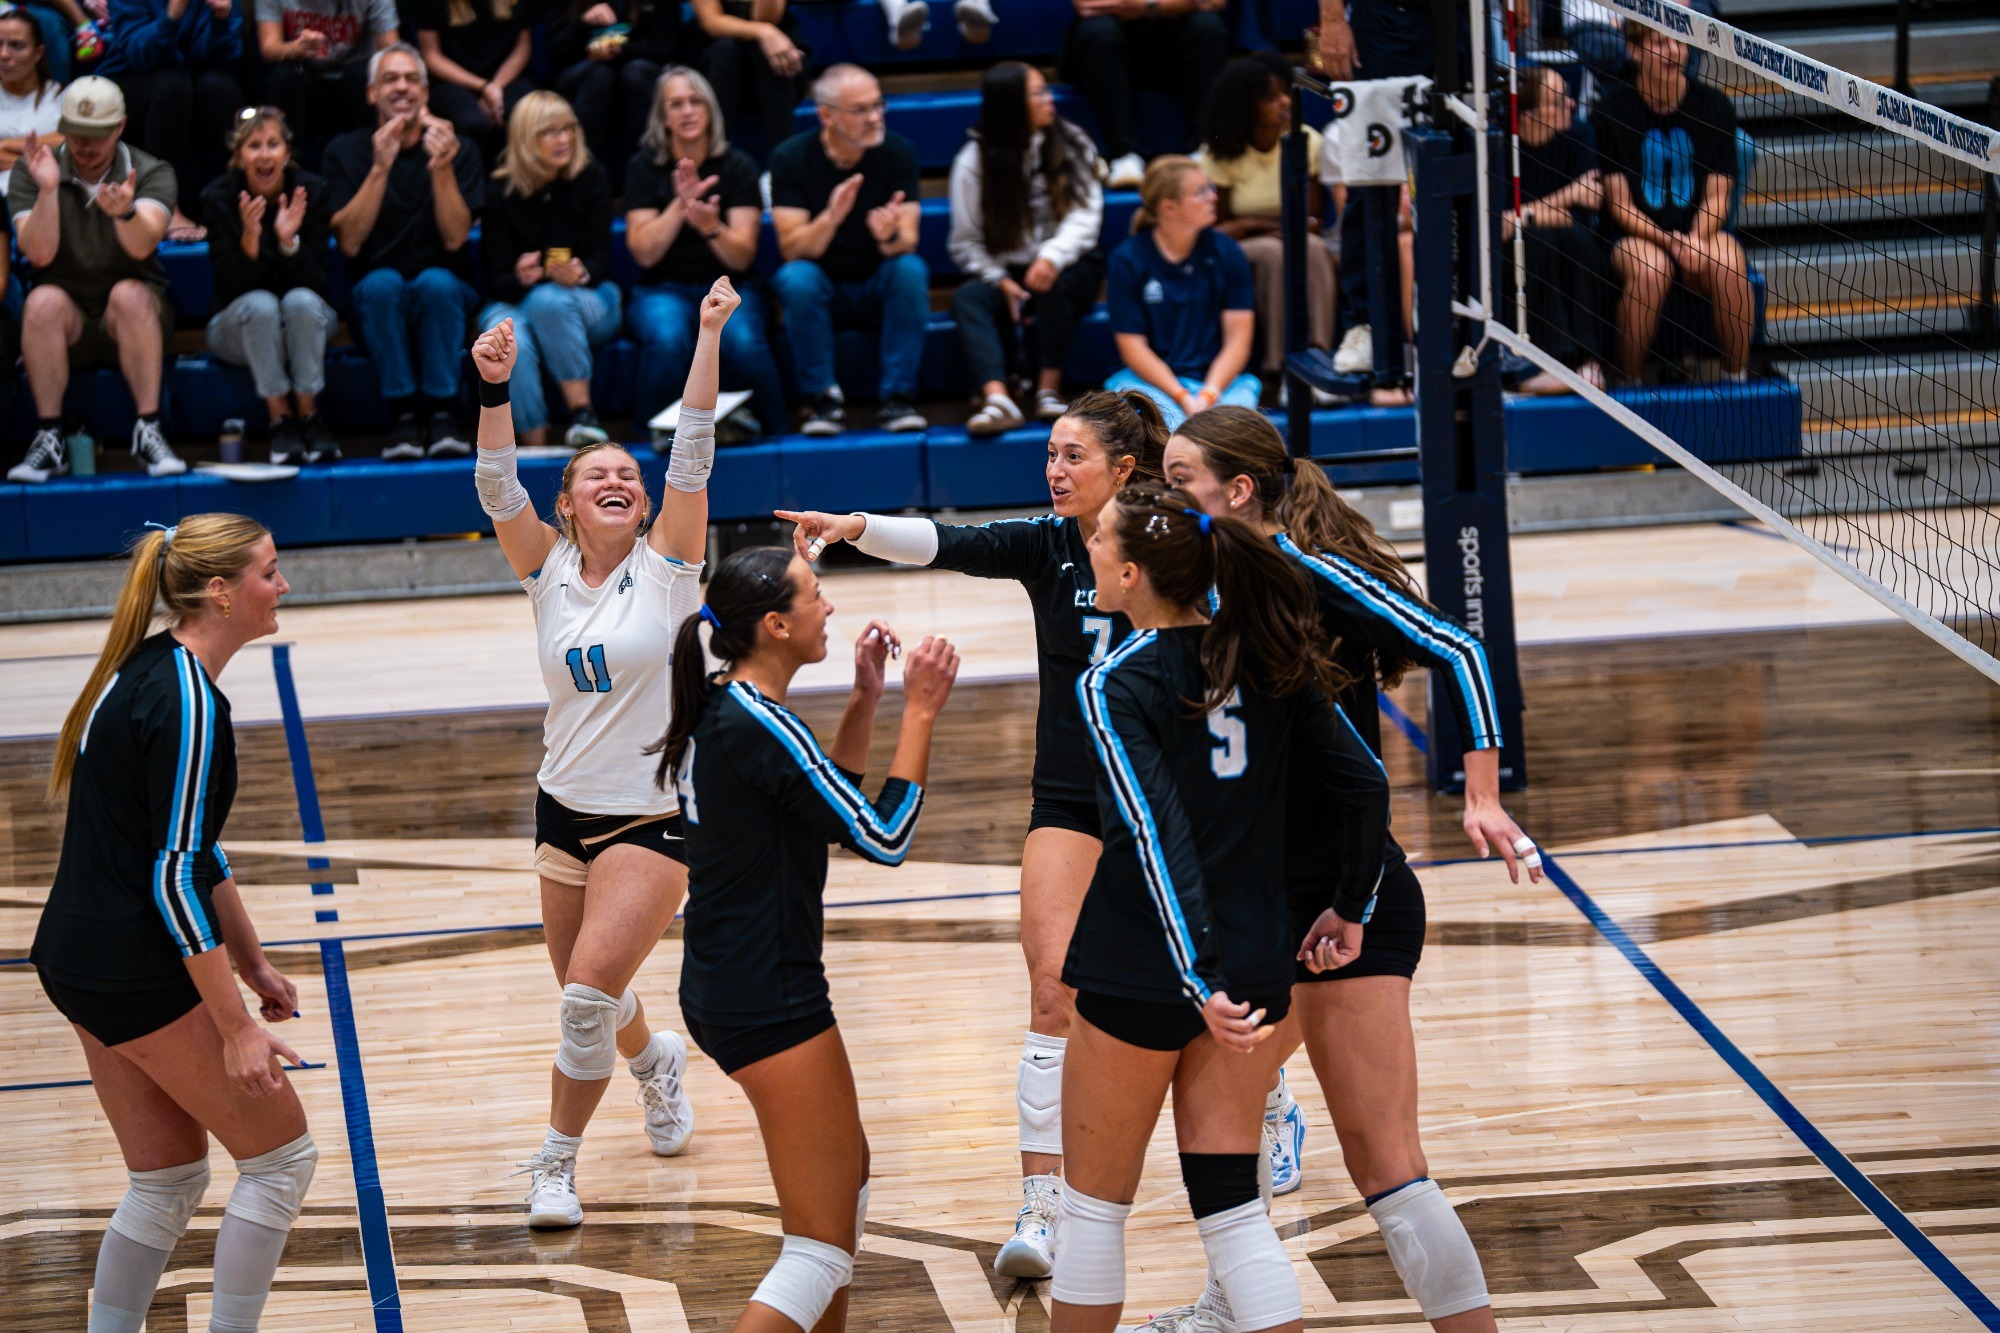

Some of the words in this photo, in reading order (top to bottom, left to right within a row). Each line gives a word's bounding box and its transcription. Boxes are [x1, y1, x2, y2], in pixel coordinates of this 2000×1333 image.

[1762, 45, 1793, 82] CRISTAN
[1457, 526, 1484, 598] sports
[565, 643, 612, 693] 11
[1082, 615, 1113, 665] 7
[1204, 684, 1249, 779] 5
[677, 735, 700, 825] 4
